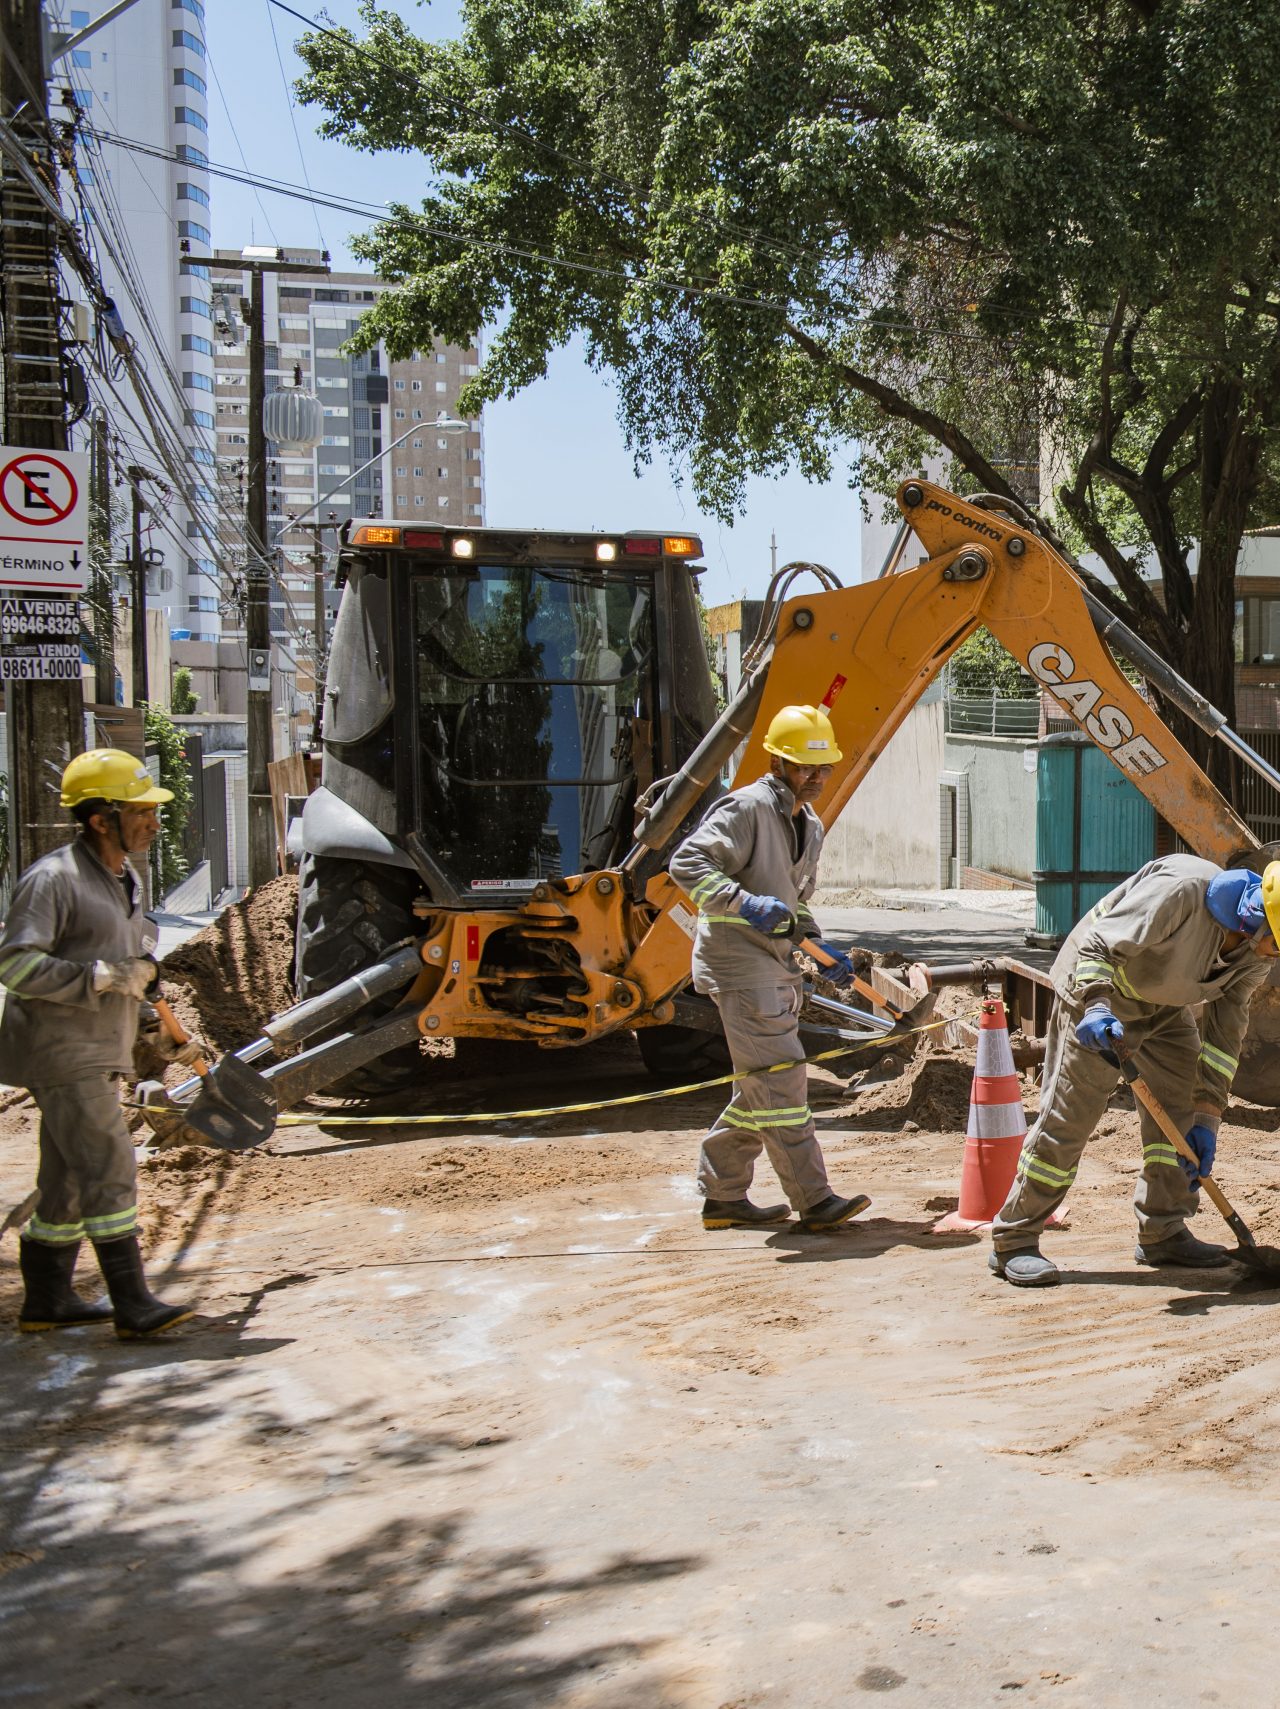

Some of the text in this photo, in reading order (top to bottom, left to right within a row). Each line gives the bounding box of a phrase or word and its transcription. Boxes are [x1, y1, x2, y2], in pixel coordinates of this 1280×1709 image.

[24, 471, 52, 508] E
[926, 500, 1003, 542] pro control
[24, 602, 75, 615] VENDE
[2, 615, 80, 635] 99646-8326
[38, 644, 80, 657] VENDO
[2, 659, 80, 678] 98611-0000
[1027, 642, 1168, 776] CASE
